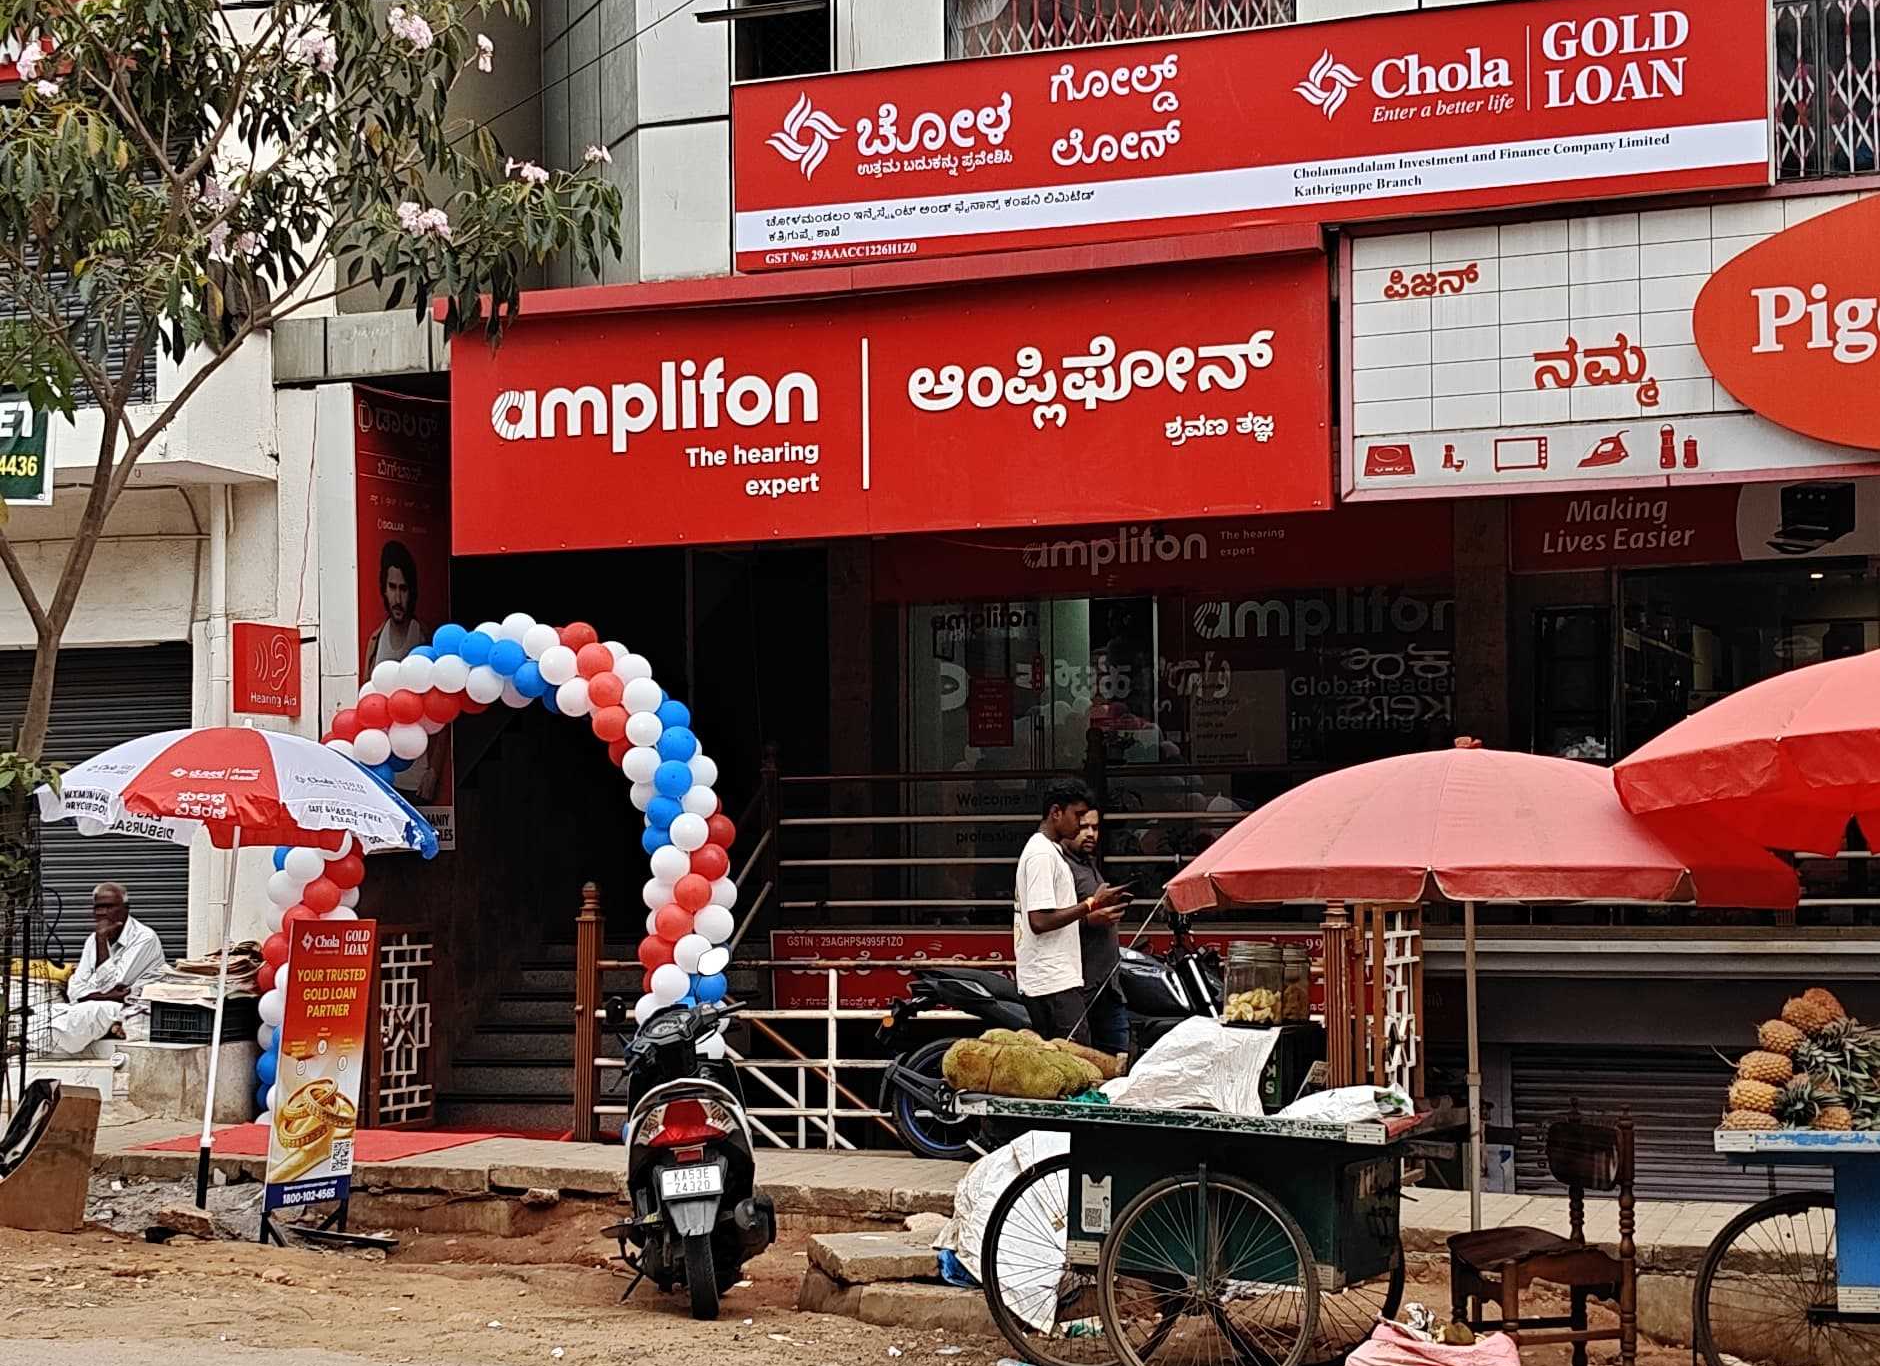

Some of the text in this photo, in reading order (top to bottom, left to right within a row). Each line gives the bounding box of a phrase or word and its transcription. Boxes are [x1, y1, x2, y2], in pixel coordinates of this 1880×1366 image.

[1541, 9, 1690, 62] GOLD
[1050, 53, 1179, 113] ಗೋಲ್ಡ್
[1370, 46, 1513, 101] Chola
[1543, 56, 1688, 109] LOAN
[1371, 93, 1515, 124] Enter a better life
[857, 92, 1013, 156] ಚೋಳ
[1051, 119, 1182, 166] ಲೋನ್
[1293, 133, 1670, 180] Cholamandalam Investment and Finance Company Limited
[858, 158, 900, 178] ಉತ್ತಮ
[904, 153, 958, 177] ಬದುಕನ್ನು
[1294, 174, 1422, 201] Kathriguppe Branch
[766, 210, 851, 229] ಚೋಳಮಂಡಲಂ
[1004, 195, 1041, 209] ಕಂಪನಿ
[765, 253, 789, 265] GST
[791, 251, 809, 263] No:
[1383, 263, 1479, 300] ಪಿಜನ್
[1751, 283, 1880, 364] Pig
[907, 330, 1275, 429] ಆಂಪ್ಲಿಫೋನ್
[1533, 331, 1660, 408] ನಮ್ಮ
[491, 357, 819, 453] amplifon
[1165, 411, 1274, 446] ಶ್ರವಣ ತಜ್ಞ
[686, 442, 819, 467] The hearing
[745, 472, 819, 497] expert
[1566, 496, 1668, 525] Making
[1023, 526, 1208, 575] amplifon
[1543, 525, 1695, 555] Lives Easier
[931, 605, 1038, 630] amplifon
[250, 691, 297, 708] Hearing Aid
[1290, 675, 1368, 696] Global
[315, 929, 370, 948] Chola GOLD
[344, 943, 368, 956] LOAN
[787, 936, 814, 947] GSTIN
[297, 968, 366, 982] YOUR TRUSTED
[303, 987, 357, 1001] GOLD LOAN
[306, 1004, 349, 1017] PARTNER
